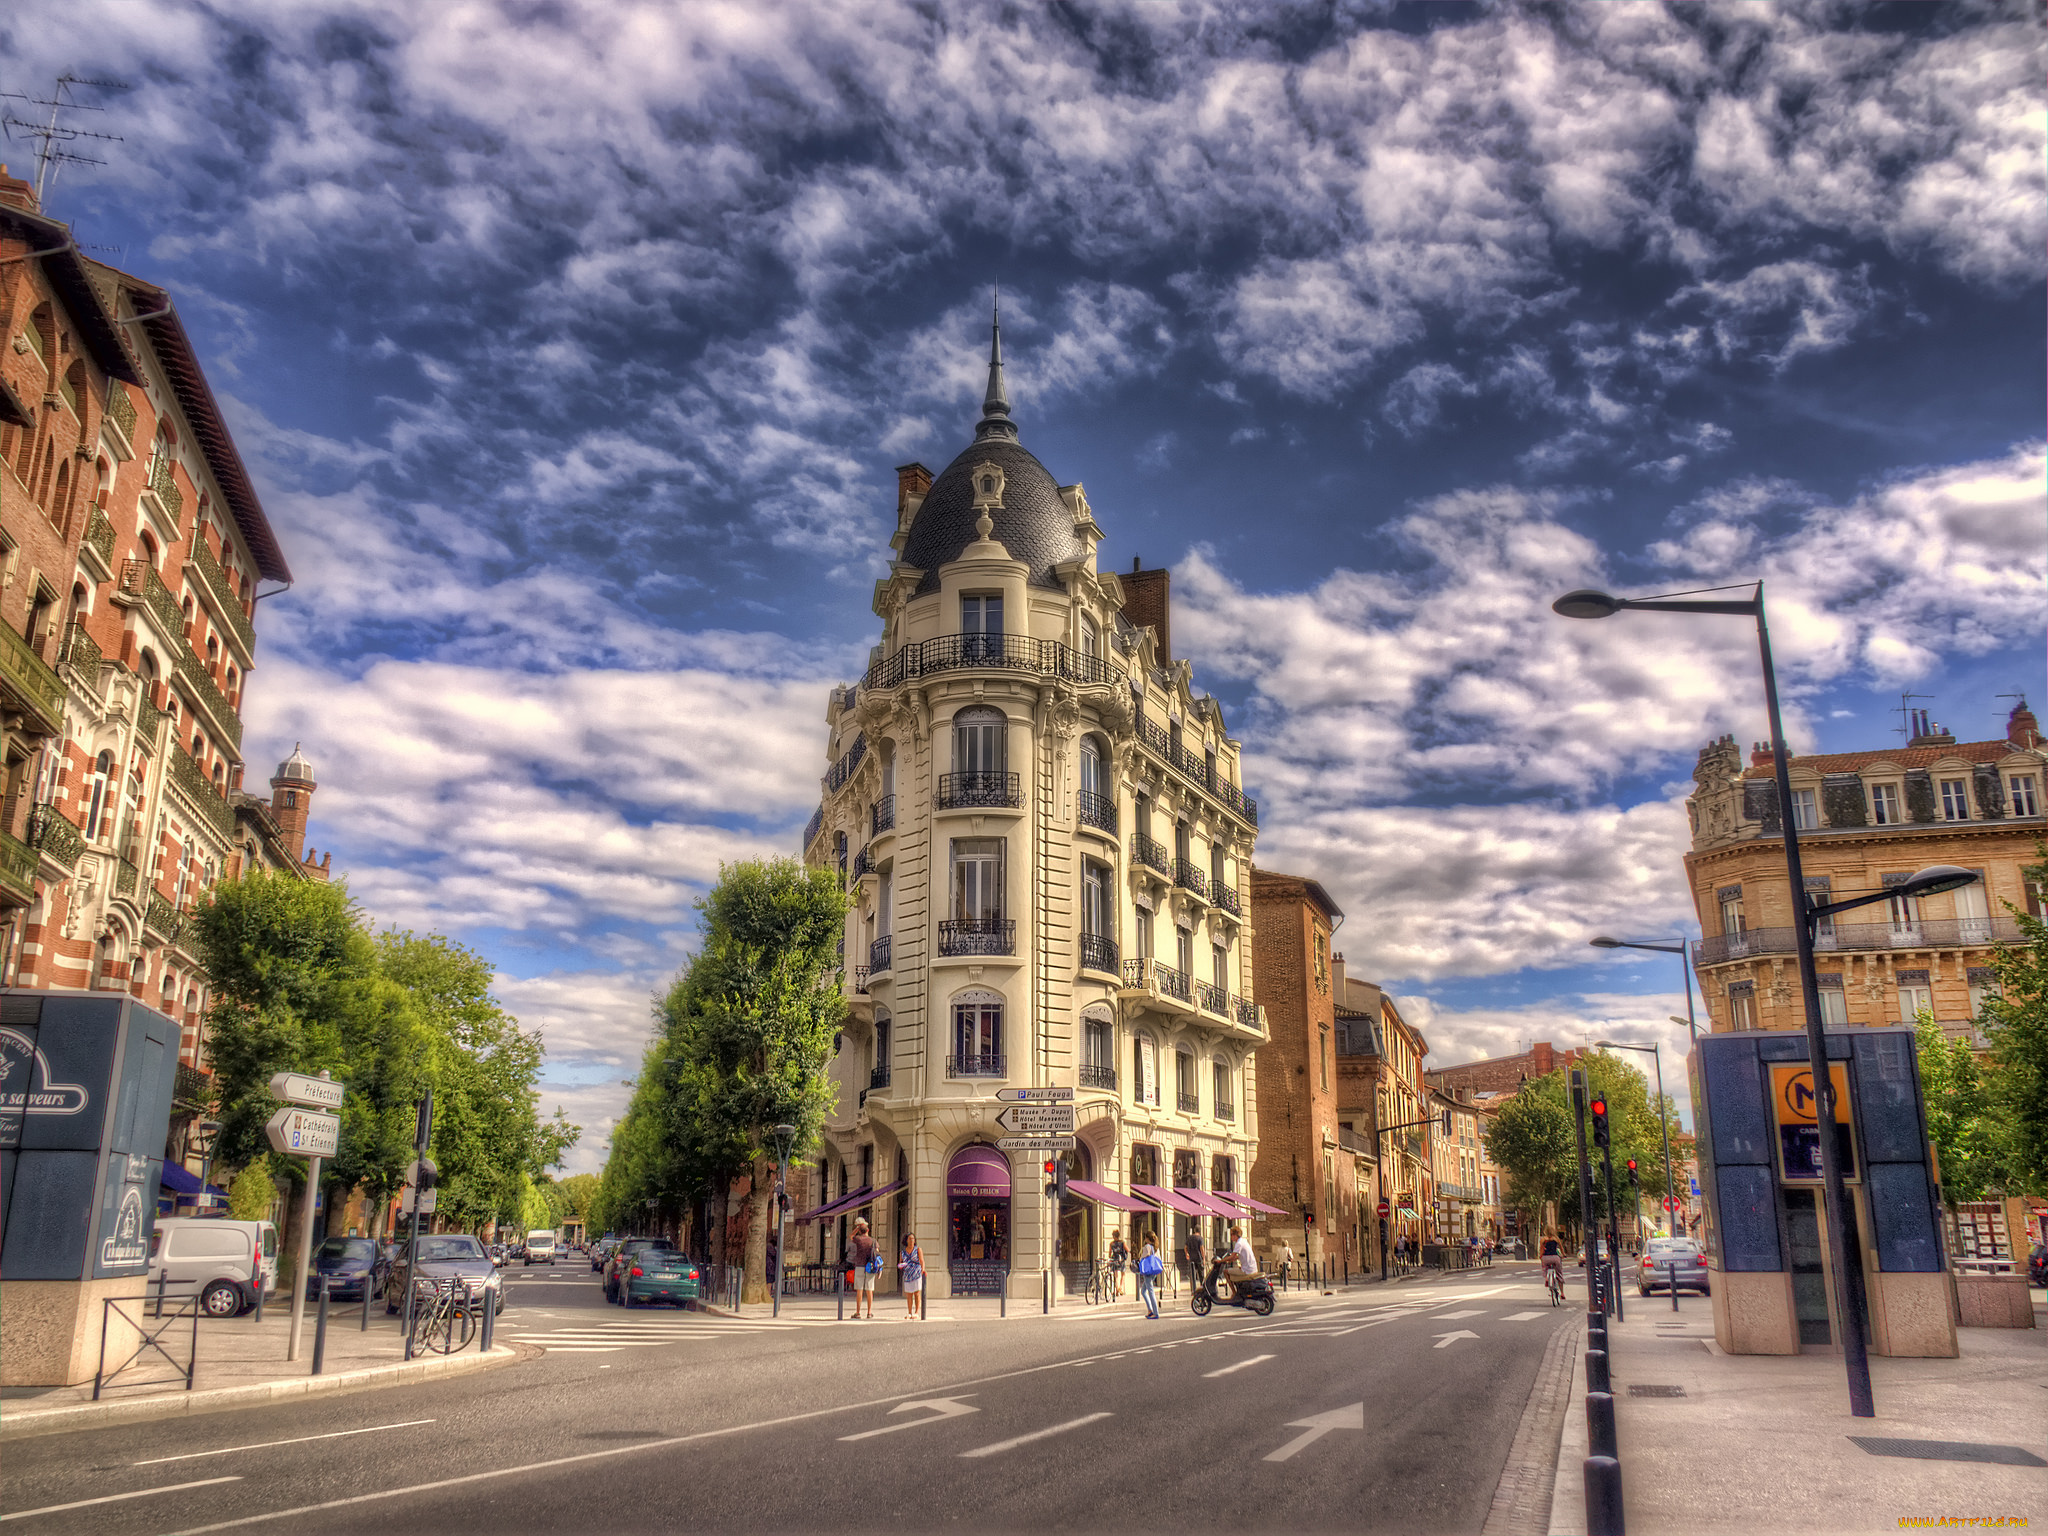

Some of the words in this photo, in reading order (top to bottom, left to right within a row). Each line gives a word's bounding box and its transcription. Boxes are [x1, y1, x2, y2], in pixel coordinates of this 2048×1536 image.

[0, 1035, 33, 1058] INCENT
[8, 1092, 66, 1106] saveurs
[304, 1083, 341, 1101] Préfecture
[303, 1118, 337, 1134] Cathédrale
[310, 1132, 335, 1150] Étienne
[1003, 1140, 1026, 1148] Jardin
